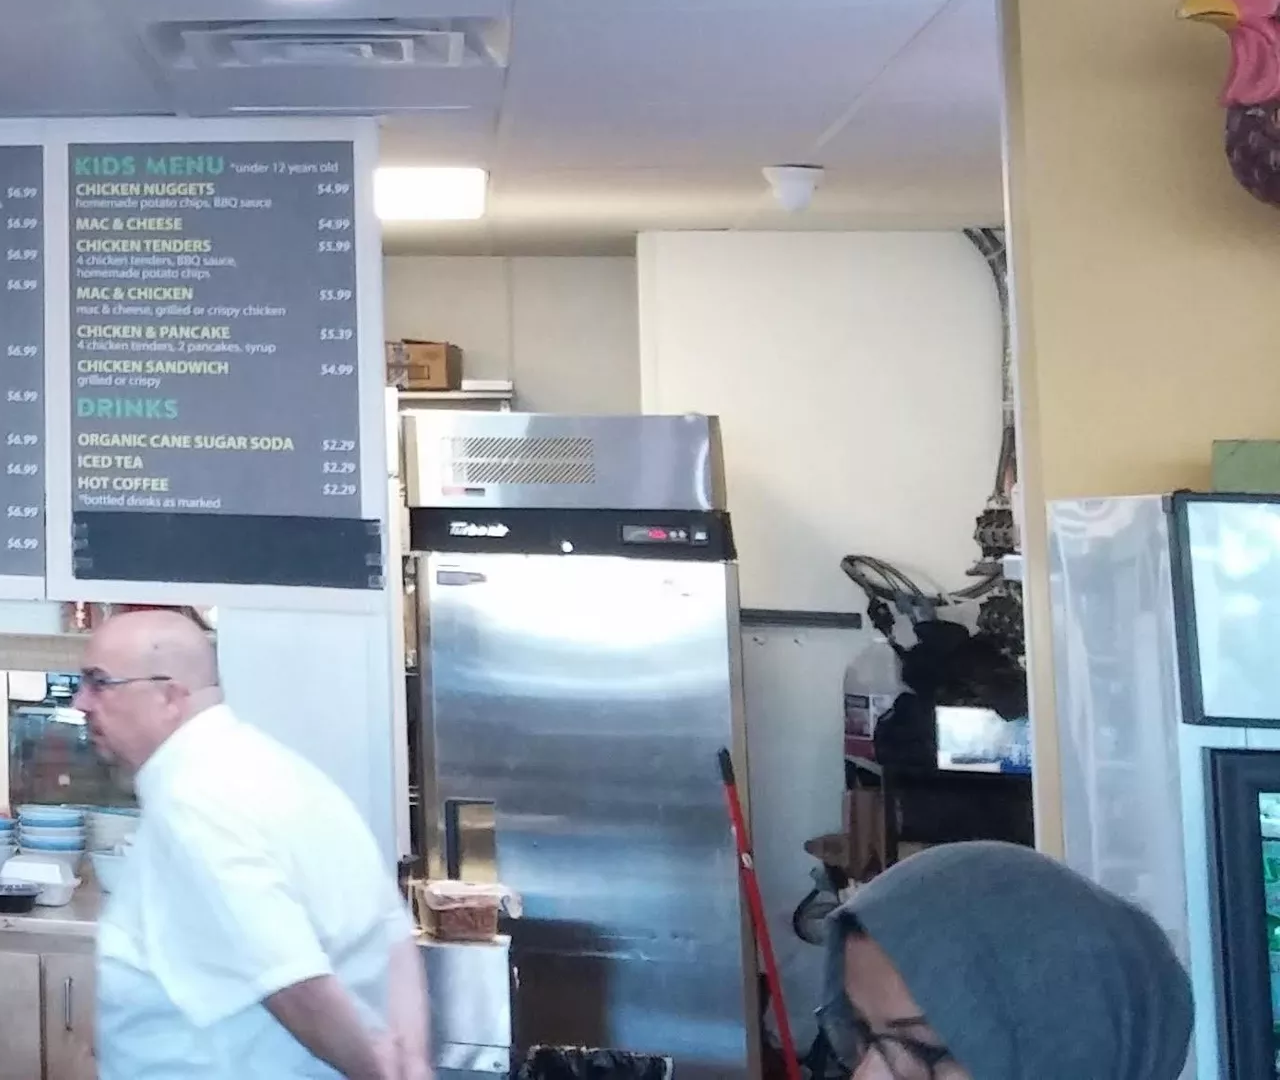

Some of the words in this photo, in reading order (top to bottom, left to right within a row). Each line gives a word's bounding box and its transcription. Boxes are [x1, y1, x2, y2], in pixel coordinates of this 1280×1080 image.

[75, 156, 135, 175] KIDS
[146, 156, 224, 175] MENU
[76, 184, 141, 195] CHICKEN
[144, 184, 215, 195] NUGGETS
[76, 218, 109, 230] MAC
[113, 218, 123, 230] &
[127, 218, 182, 230] CHEESE
[77, 240, 141, 252] CHICKEN
[144, 240, 211, 252] TENDERS
[77, 288, 111, 300] MAC
[113, 288, 124, 300] &
[128, 288, 193, 300] CHICKEN
[77, 326, 142, 338] CHICKEN
[146, 326, 156, 338] &
[160, 326, 231, 339] PANCAKE
[77, 360, 144, 373] CHICKEN
[146, 361, 229, 374] SANDWICH
[77, 399, 179, 418] DRINKS
[78, 434, 147, 448] ORGANIC
[150, 435, 191, 449] CANE
[194, 436, 247, 450] SUGAR
[251, 437, 294, 451] SODA
[323, 440, 355, 451] $2.29
[78, 456, 112, 468] ICED
[116, 456, 144, 468] TEA
[78, 477, 111, 491] HOT
[113, 478, 169, 492] COFFEE
